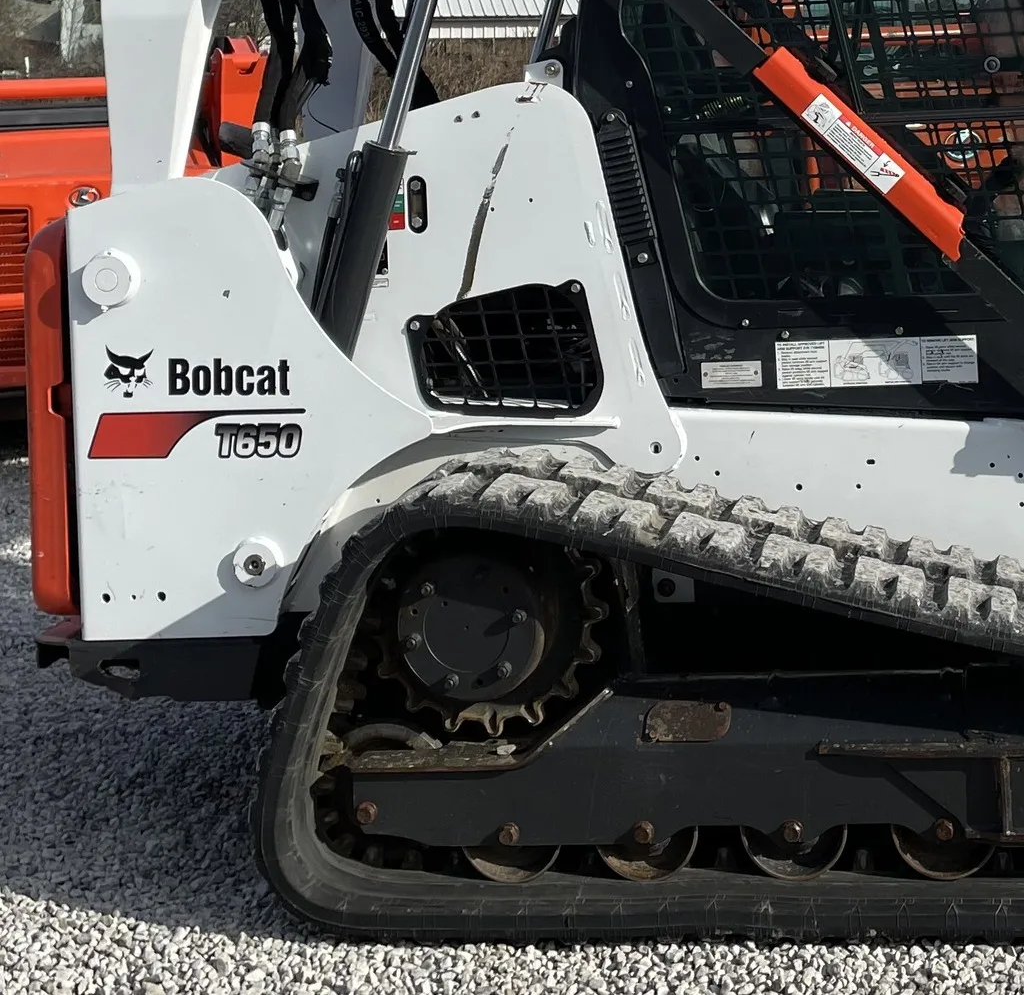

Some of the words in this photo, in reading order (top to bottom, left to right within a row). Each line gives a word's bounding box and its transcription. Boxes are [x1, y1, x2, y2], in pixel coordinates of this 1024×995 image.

[851, 126, 875, 149] DANGER
[168, 357, 290, 396] Bobcat
[214, 422, 303, 458] T650
